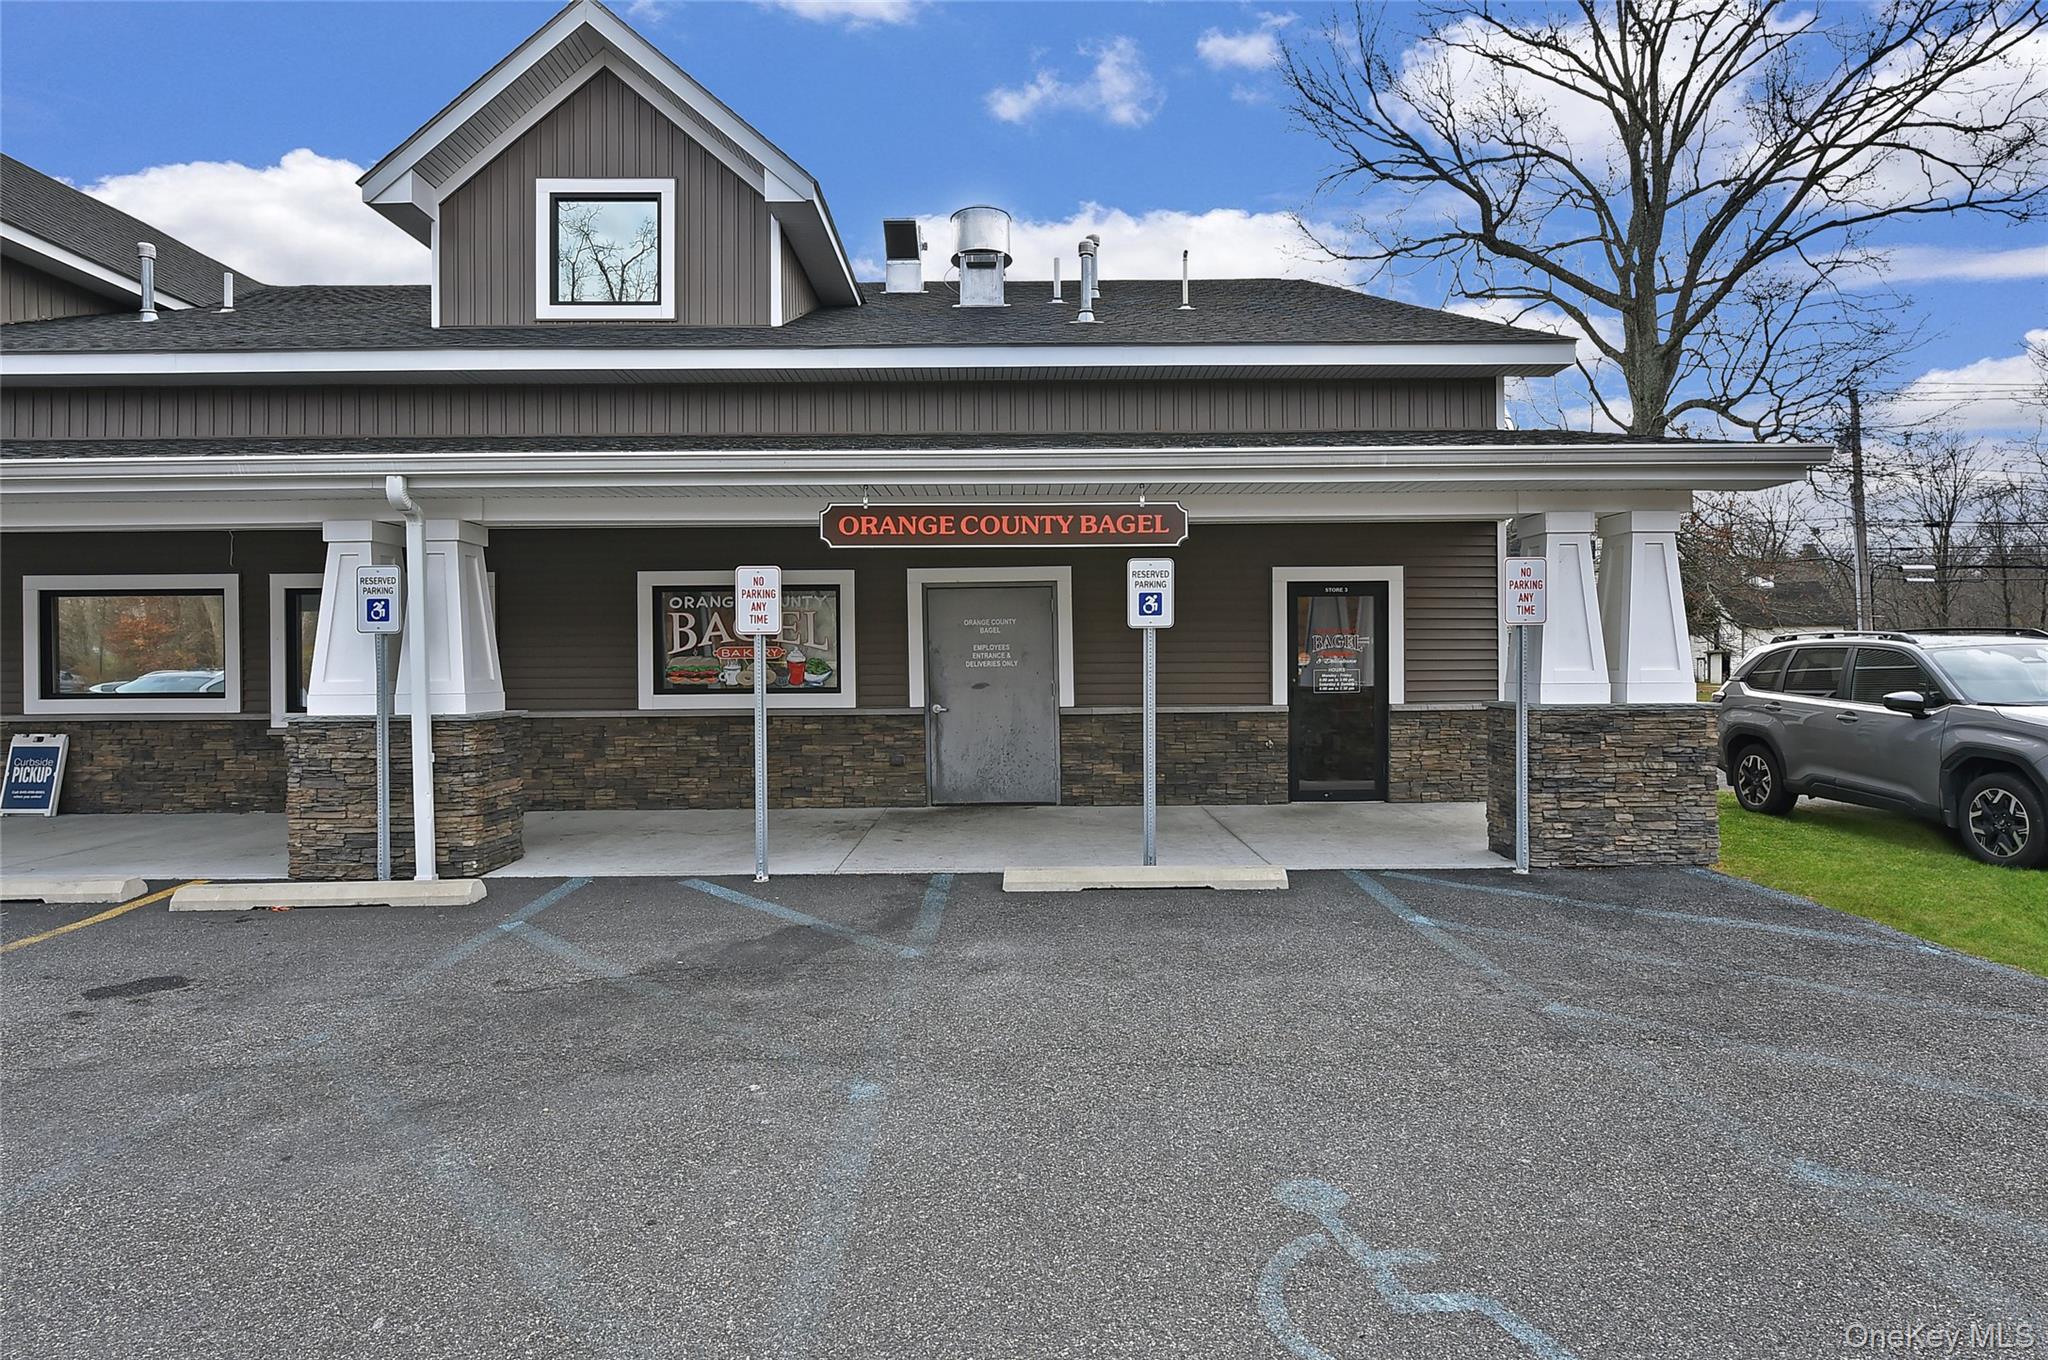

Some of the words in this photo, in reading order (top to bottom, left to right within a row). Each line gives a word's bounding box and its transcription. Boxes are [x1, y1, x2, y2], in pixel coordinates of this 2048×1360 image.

[838, 515, 955, 536] ORANGE
[960, 514, 1074, 535] COUNTY
[1079, 514, 1170, 534] BAGEL
[1132, 570, 1170, 578] RESERVED
[1520, 567, 1532, 577] NO
[360, 576, 397, 585] RESERVED
[752, 576, 765, 586] NO
[1134, 580, 1167, 588] PARKING
[1509, 580, 1543, 590] PARKING
[362, 586, 394, 595] PARKING
[741, 589, 776, 599] PARKING
[669, 595, 734, 609] ORANG
[1518, 592, 1534, 602] ANY
[750, 601, 767, 611] ANY
[1516, 605, 1536, 615] TIME
[749, 614, 769, 625] TIME
[963, 618, 990, 626] ORANGE
[991, 618, 1017, 626] COUNTY
[1312, 634, 1363, 653] BAGEL
[721, 648, 779, 658] BAKRY
[972, 652, 1006, 660] ENTRANCE
[965, 660, 1001, 668] DELIVERIES
[14, 757, 54, 767] Curbside
[11, 766, 53, 783] PICKUP
